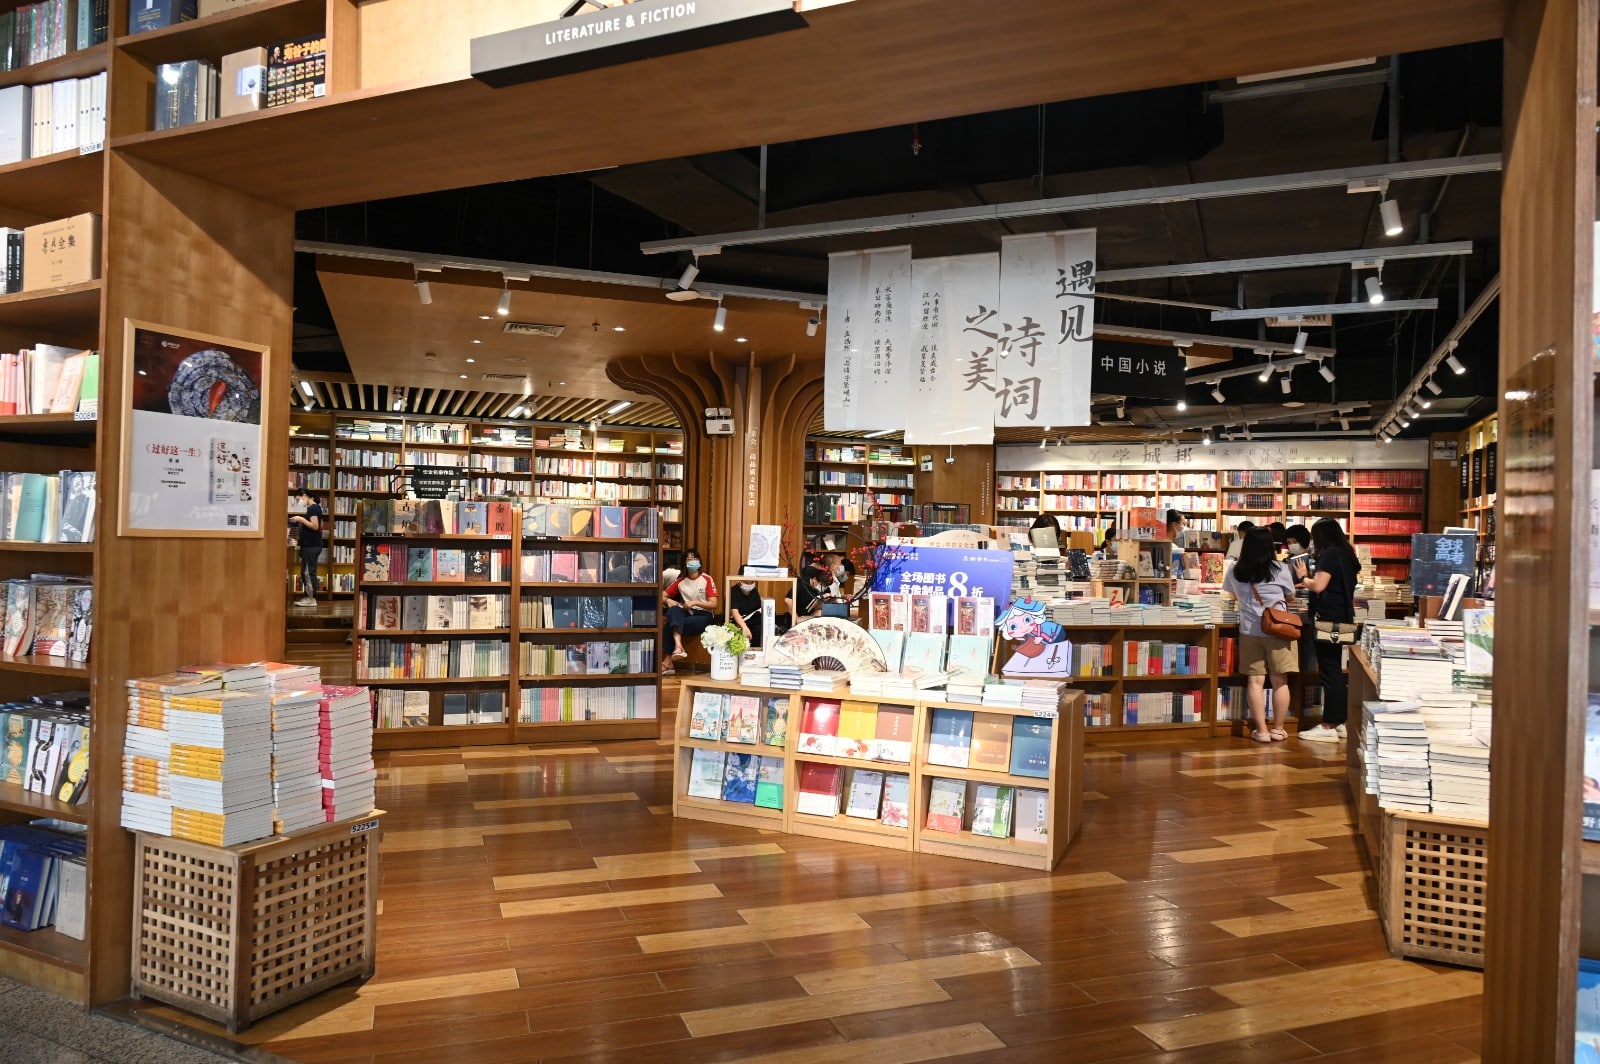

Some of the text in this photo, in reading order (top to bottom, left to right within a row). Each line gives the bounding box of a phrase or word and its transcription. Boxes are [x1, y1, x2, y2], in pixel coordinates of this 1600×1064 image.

[545, 2, 696, 45] LITERATURE & FICTION
[1055, 260, 1096, 344] 遇见
[962, 305, 998, 392] 之美
[995, 316, 1045, 421] 诗词
[1101, 355, 1167, 376] 中国小说
[146, 443, 201, 458] 《过好这一生》
[1435, 536, 1464, 551] 全球
[1435, 550, 1466, 565] 高考
[900, 571, 947, 584] 全场图书
[899, 584, 946, 596] 音像制品
